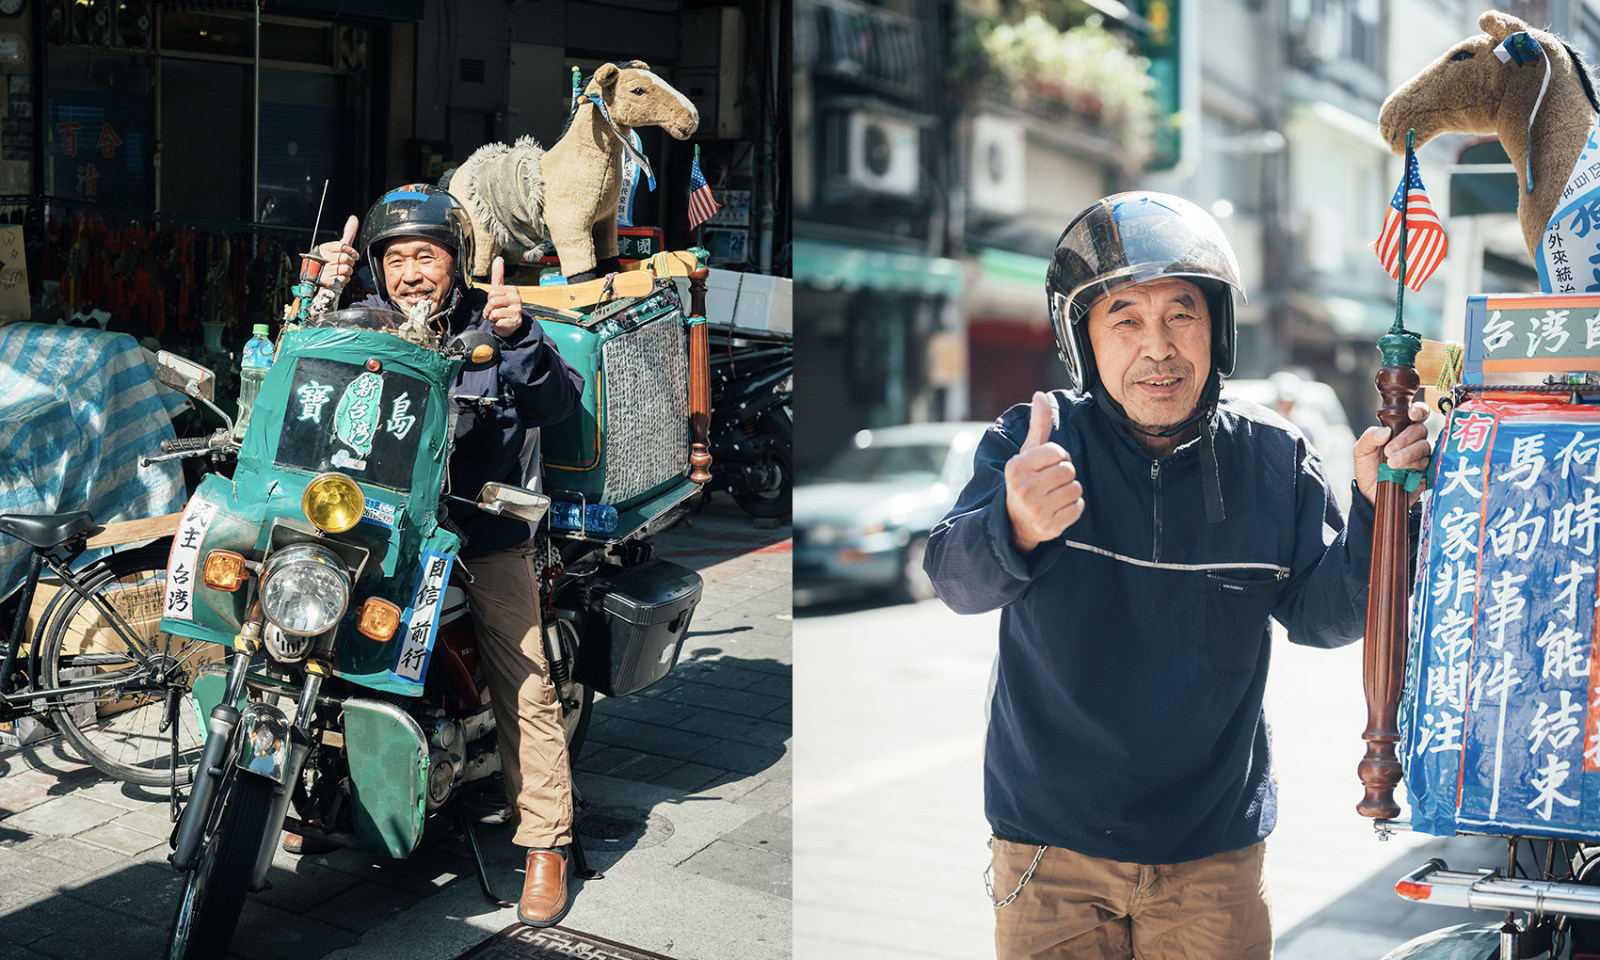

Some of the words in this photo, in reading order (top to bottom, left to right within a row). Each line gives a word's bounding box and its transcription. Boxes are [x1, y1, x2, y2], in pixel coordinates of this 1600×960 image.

[347, 376, 379, 445] 新台湾
[386, 391, 416, 440] 島
[400, 558, 447, 672] 自信前行
